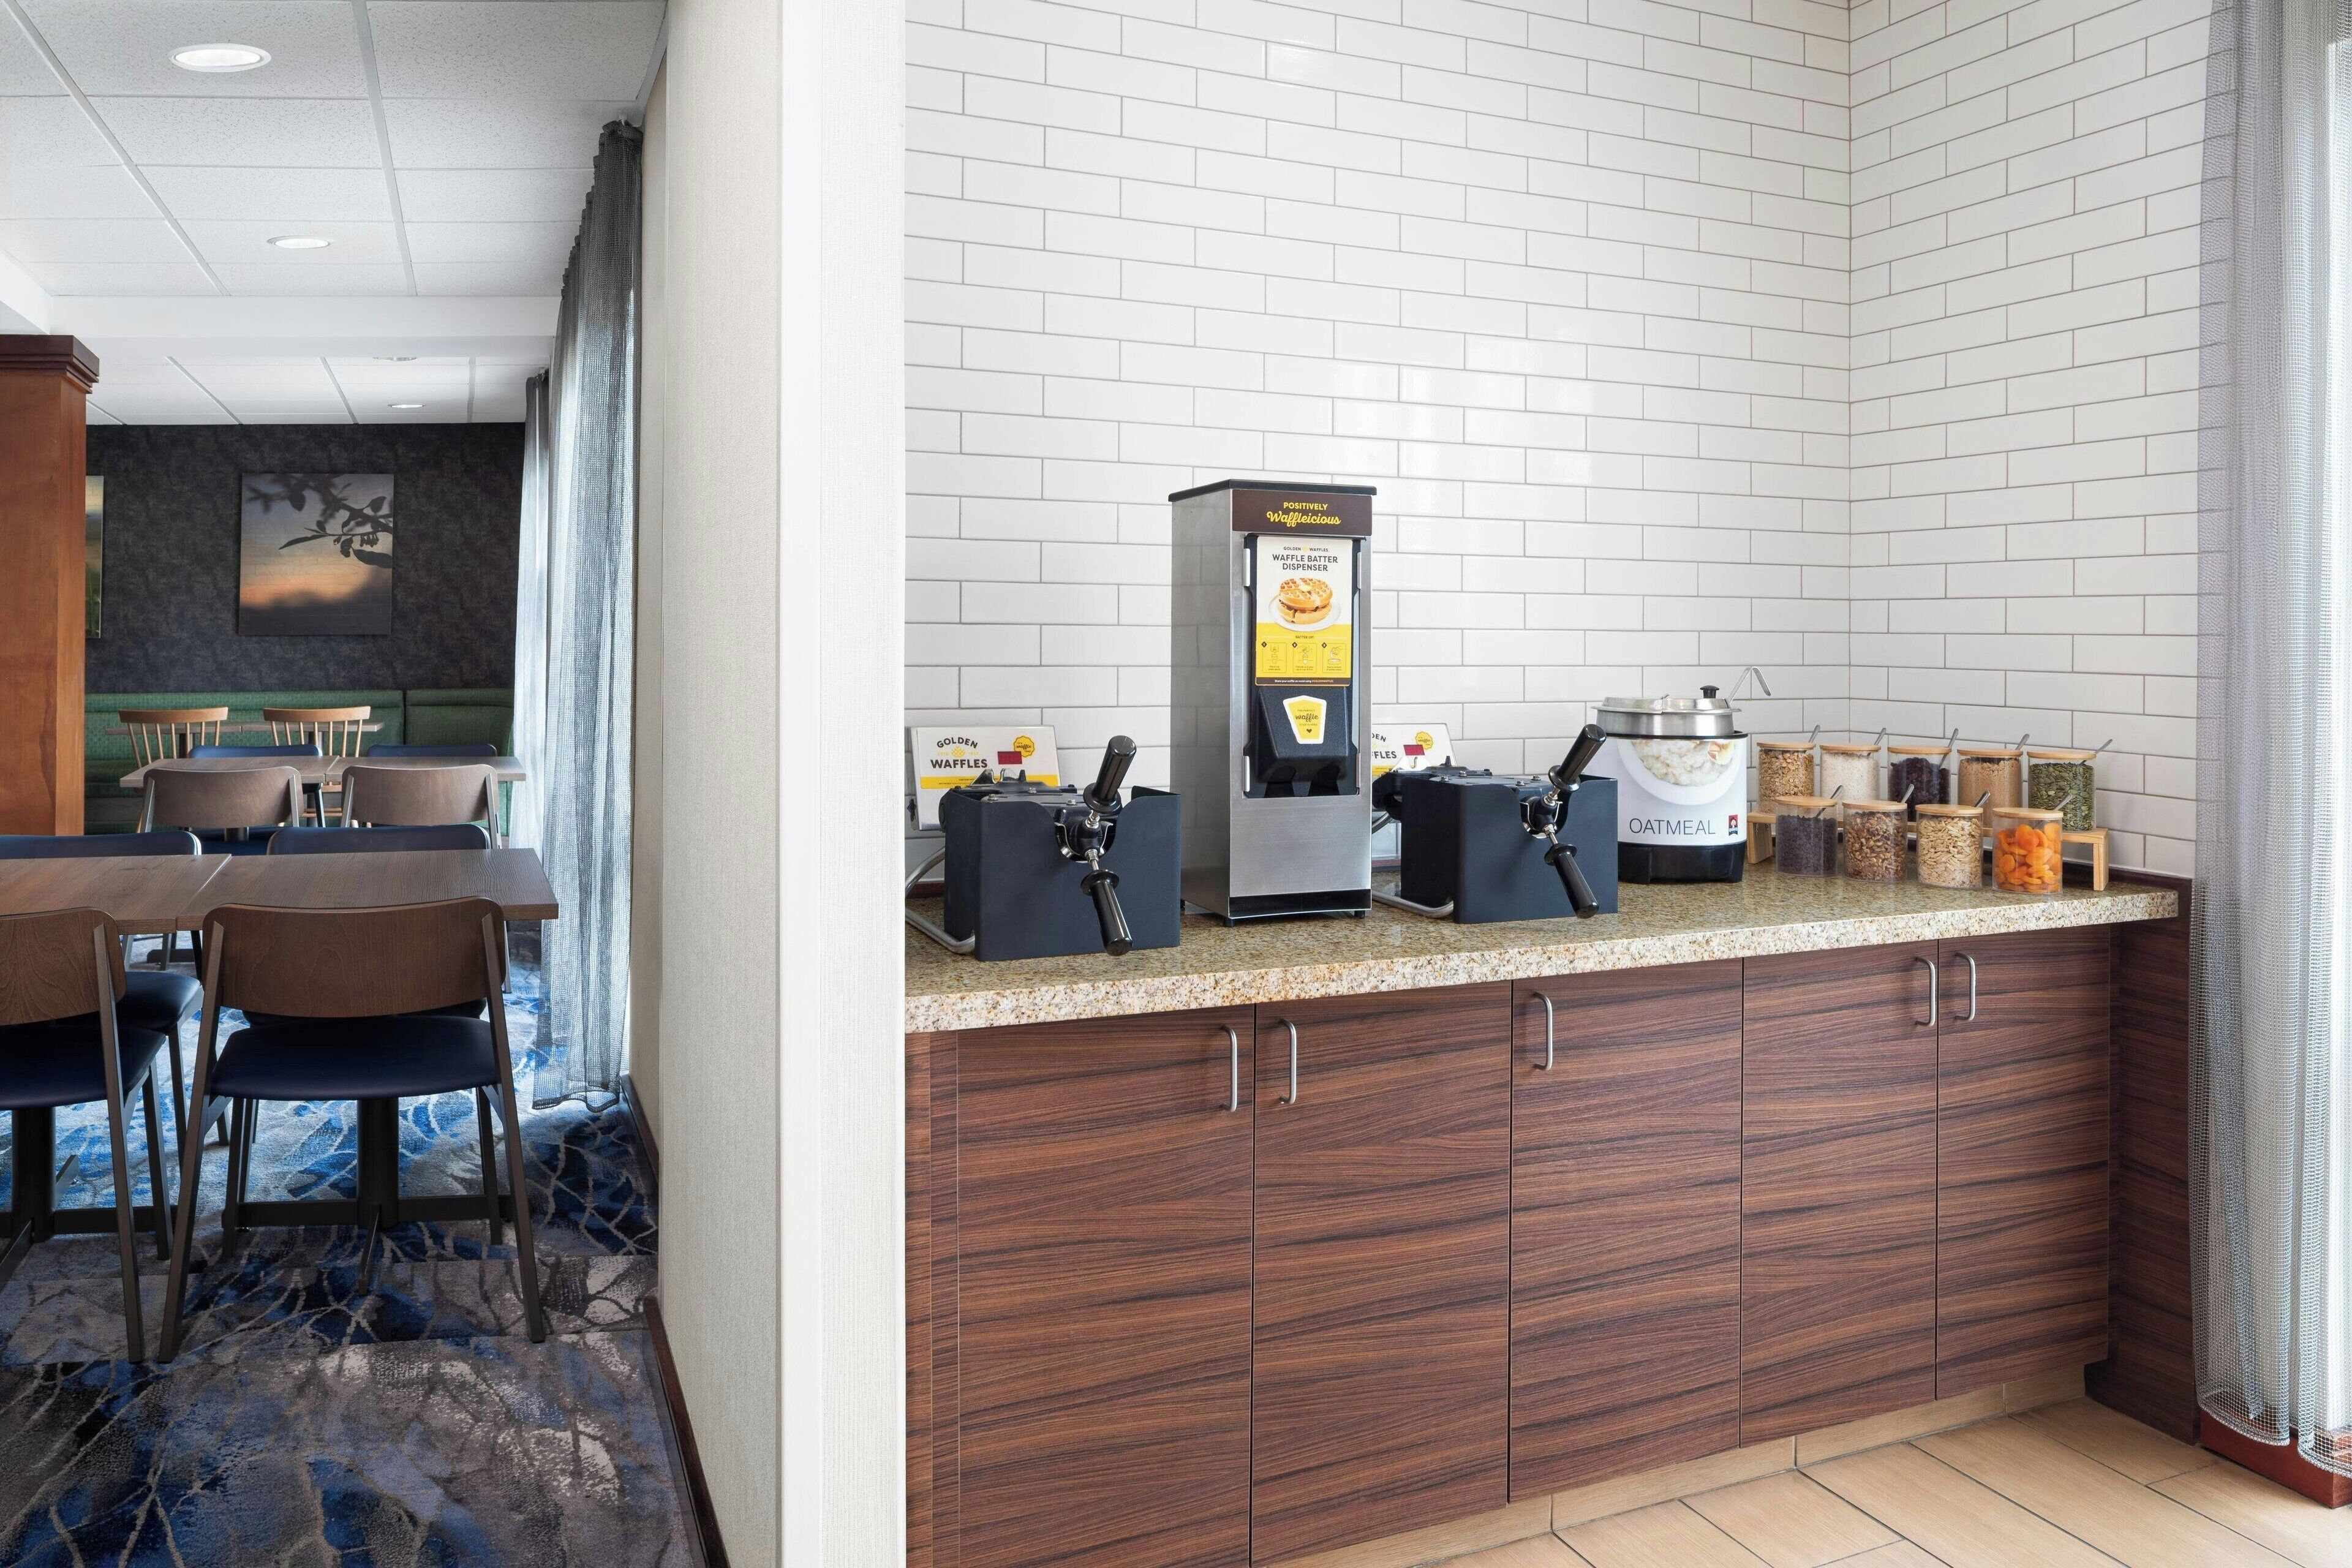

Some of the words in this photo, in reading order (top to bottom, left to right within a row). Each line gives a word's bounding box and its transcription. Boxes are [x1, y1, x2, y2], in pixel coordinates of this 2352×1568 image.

[1267, 511, 1341, 527] Waffleicious
[1295, 714, 1319, 723] waffle
[937, 737, 978, 748] GOLDEN
[1372, 733, 1386, 742] DEN
[930, 759, 988, 769] WAFFLES
[1629, 818, 1716, 835] OATMEAL
